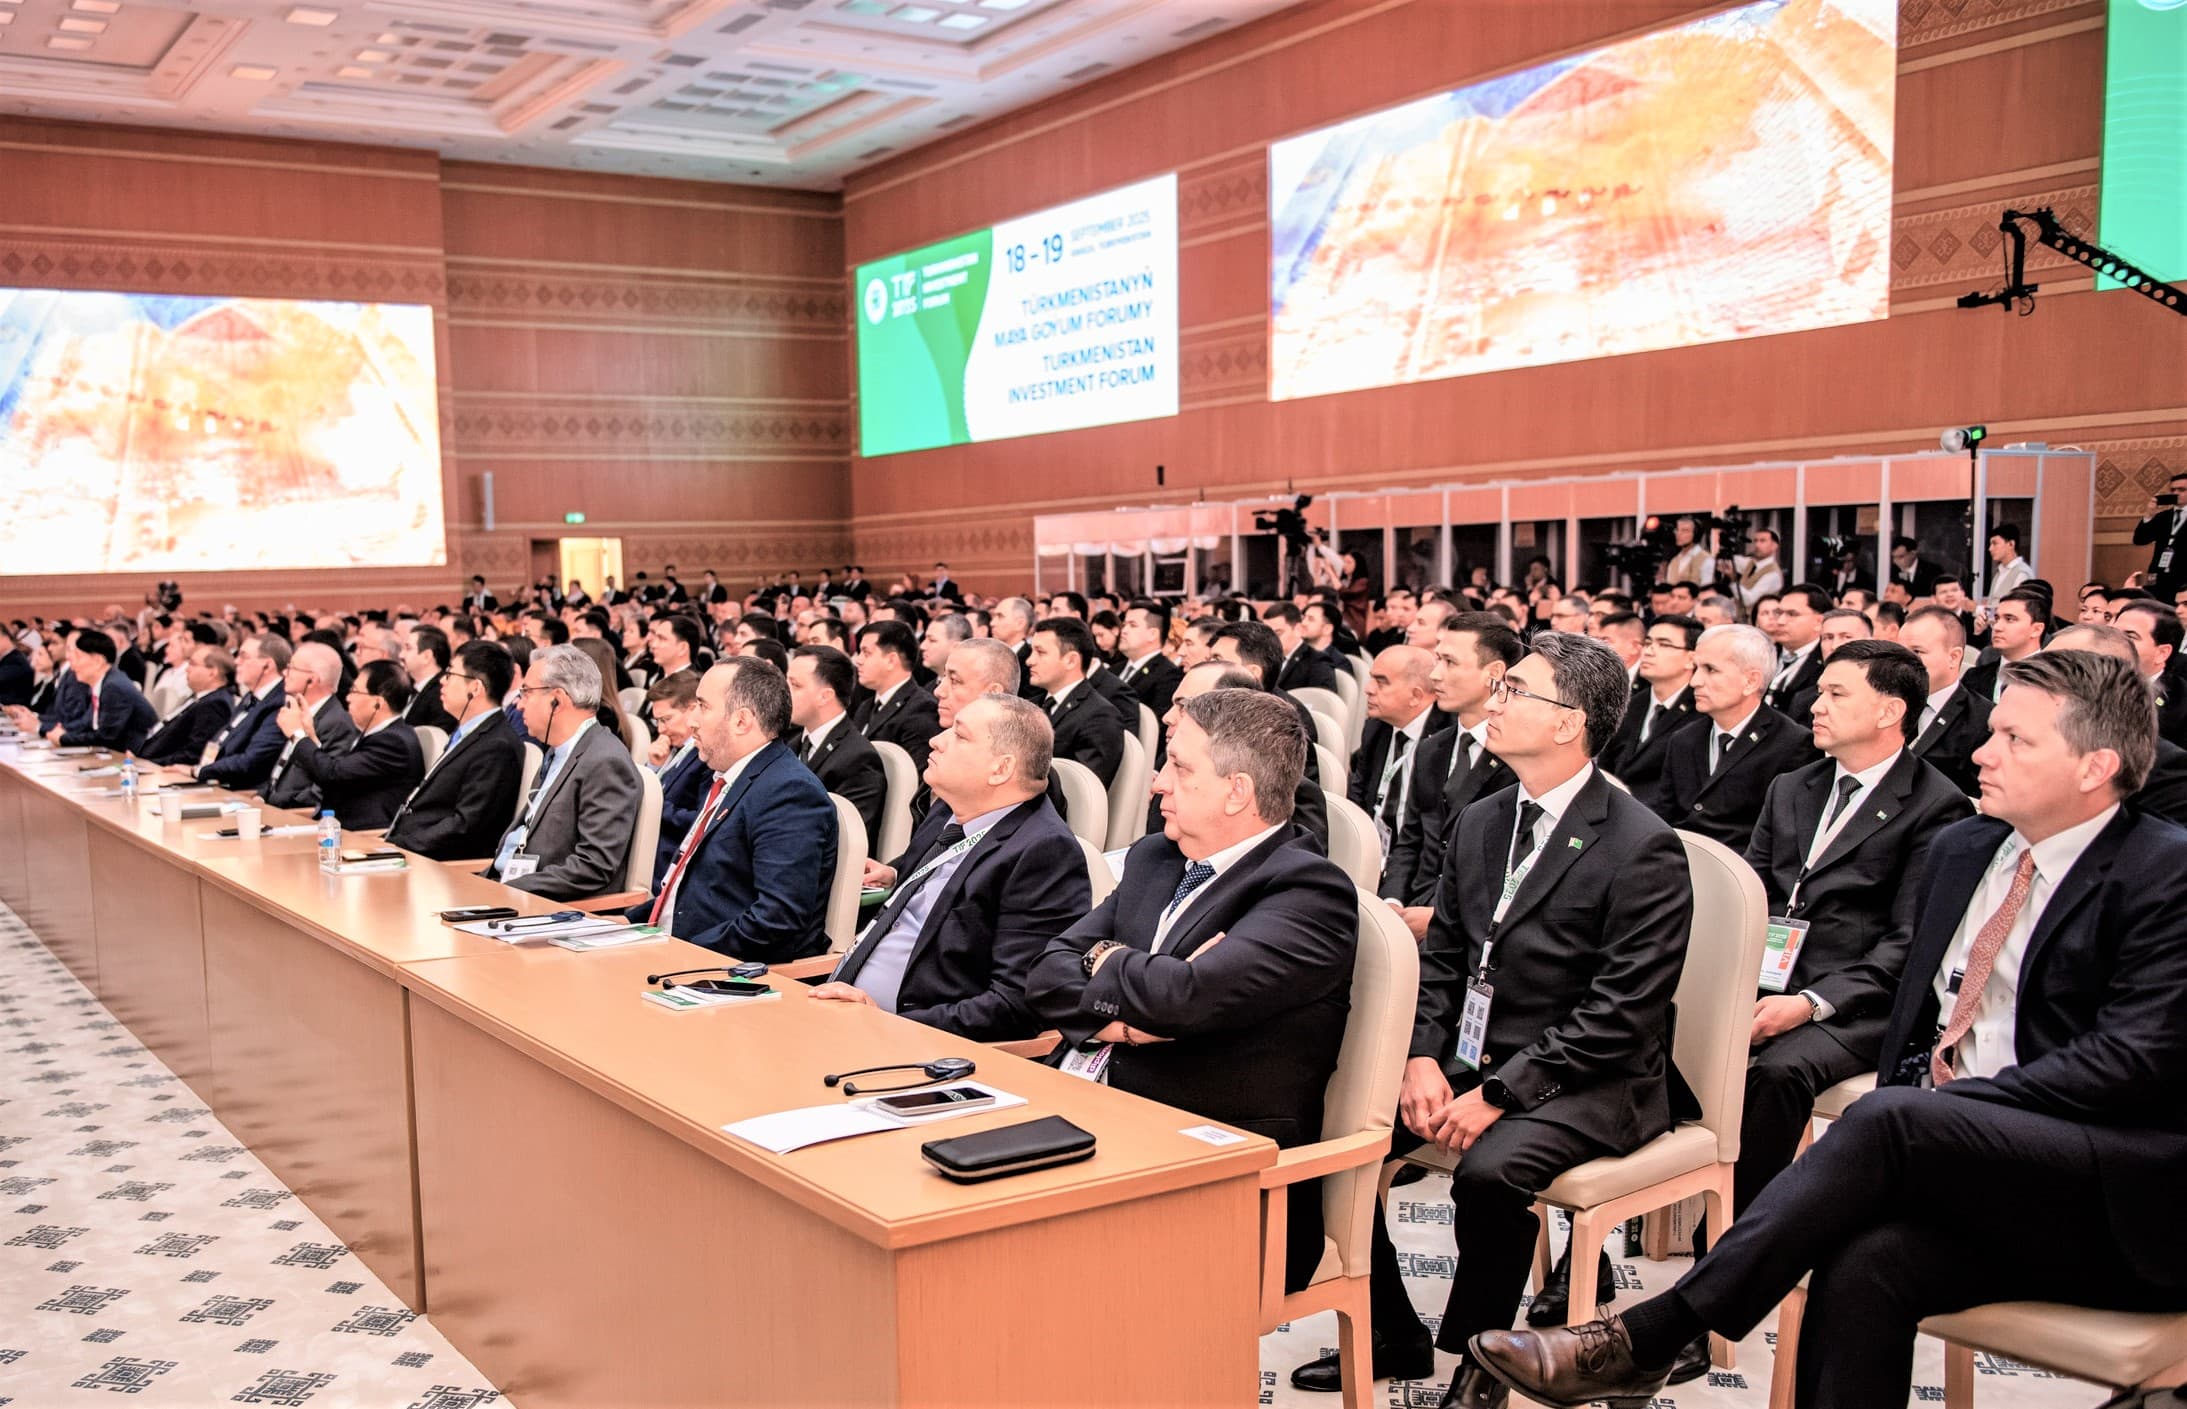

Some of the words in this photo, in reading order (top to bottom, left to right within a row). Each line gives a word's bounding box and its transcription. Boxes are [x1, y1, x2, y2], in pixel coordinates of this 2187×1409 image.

[1042, 334, 1155, 372] TURKMENISTAN
[1007, 373, 1095, 404] INVESTMENT
[1099, 363, 1155, 389] FORUM
